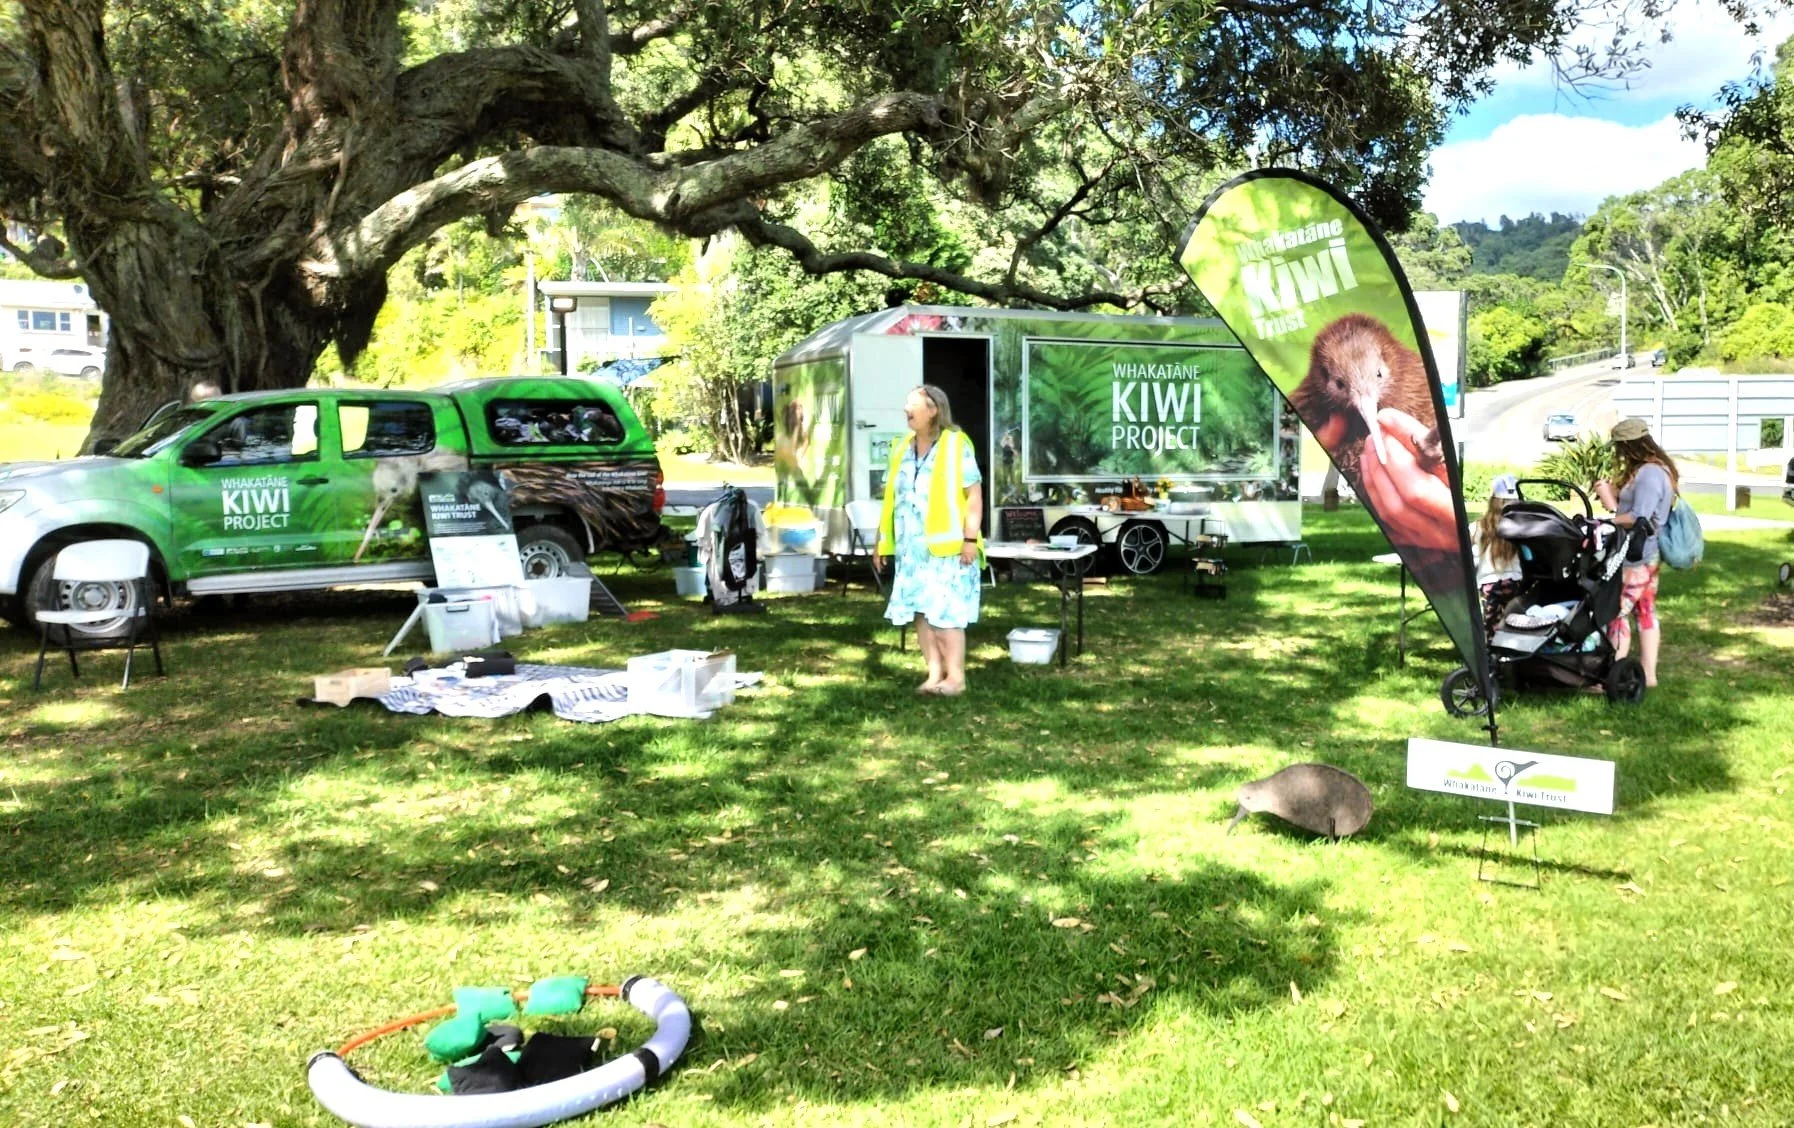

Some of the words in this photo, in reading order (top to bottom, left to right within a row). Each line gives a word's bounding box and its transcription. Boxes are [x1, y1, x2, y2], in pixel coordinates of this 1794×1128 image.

[1254, 308, 1308, 340] Trust
[1112, 362, 1201, 380] WHAKATĀNE
[1112, 381, 1201, 423] KIWI
[1112, 425, 1201, 456] PROJECT
[221, 475, 289, 489] WHAKATĀNE
[222, 488, 291, 515] KIWI
[223, 513, 291, 531] PROJECT
[1516, 788, 1537, 799] Kiwi
[1541, 791, 1566, 803] Trust
